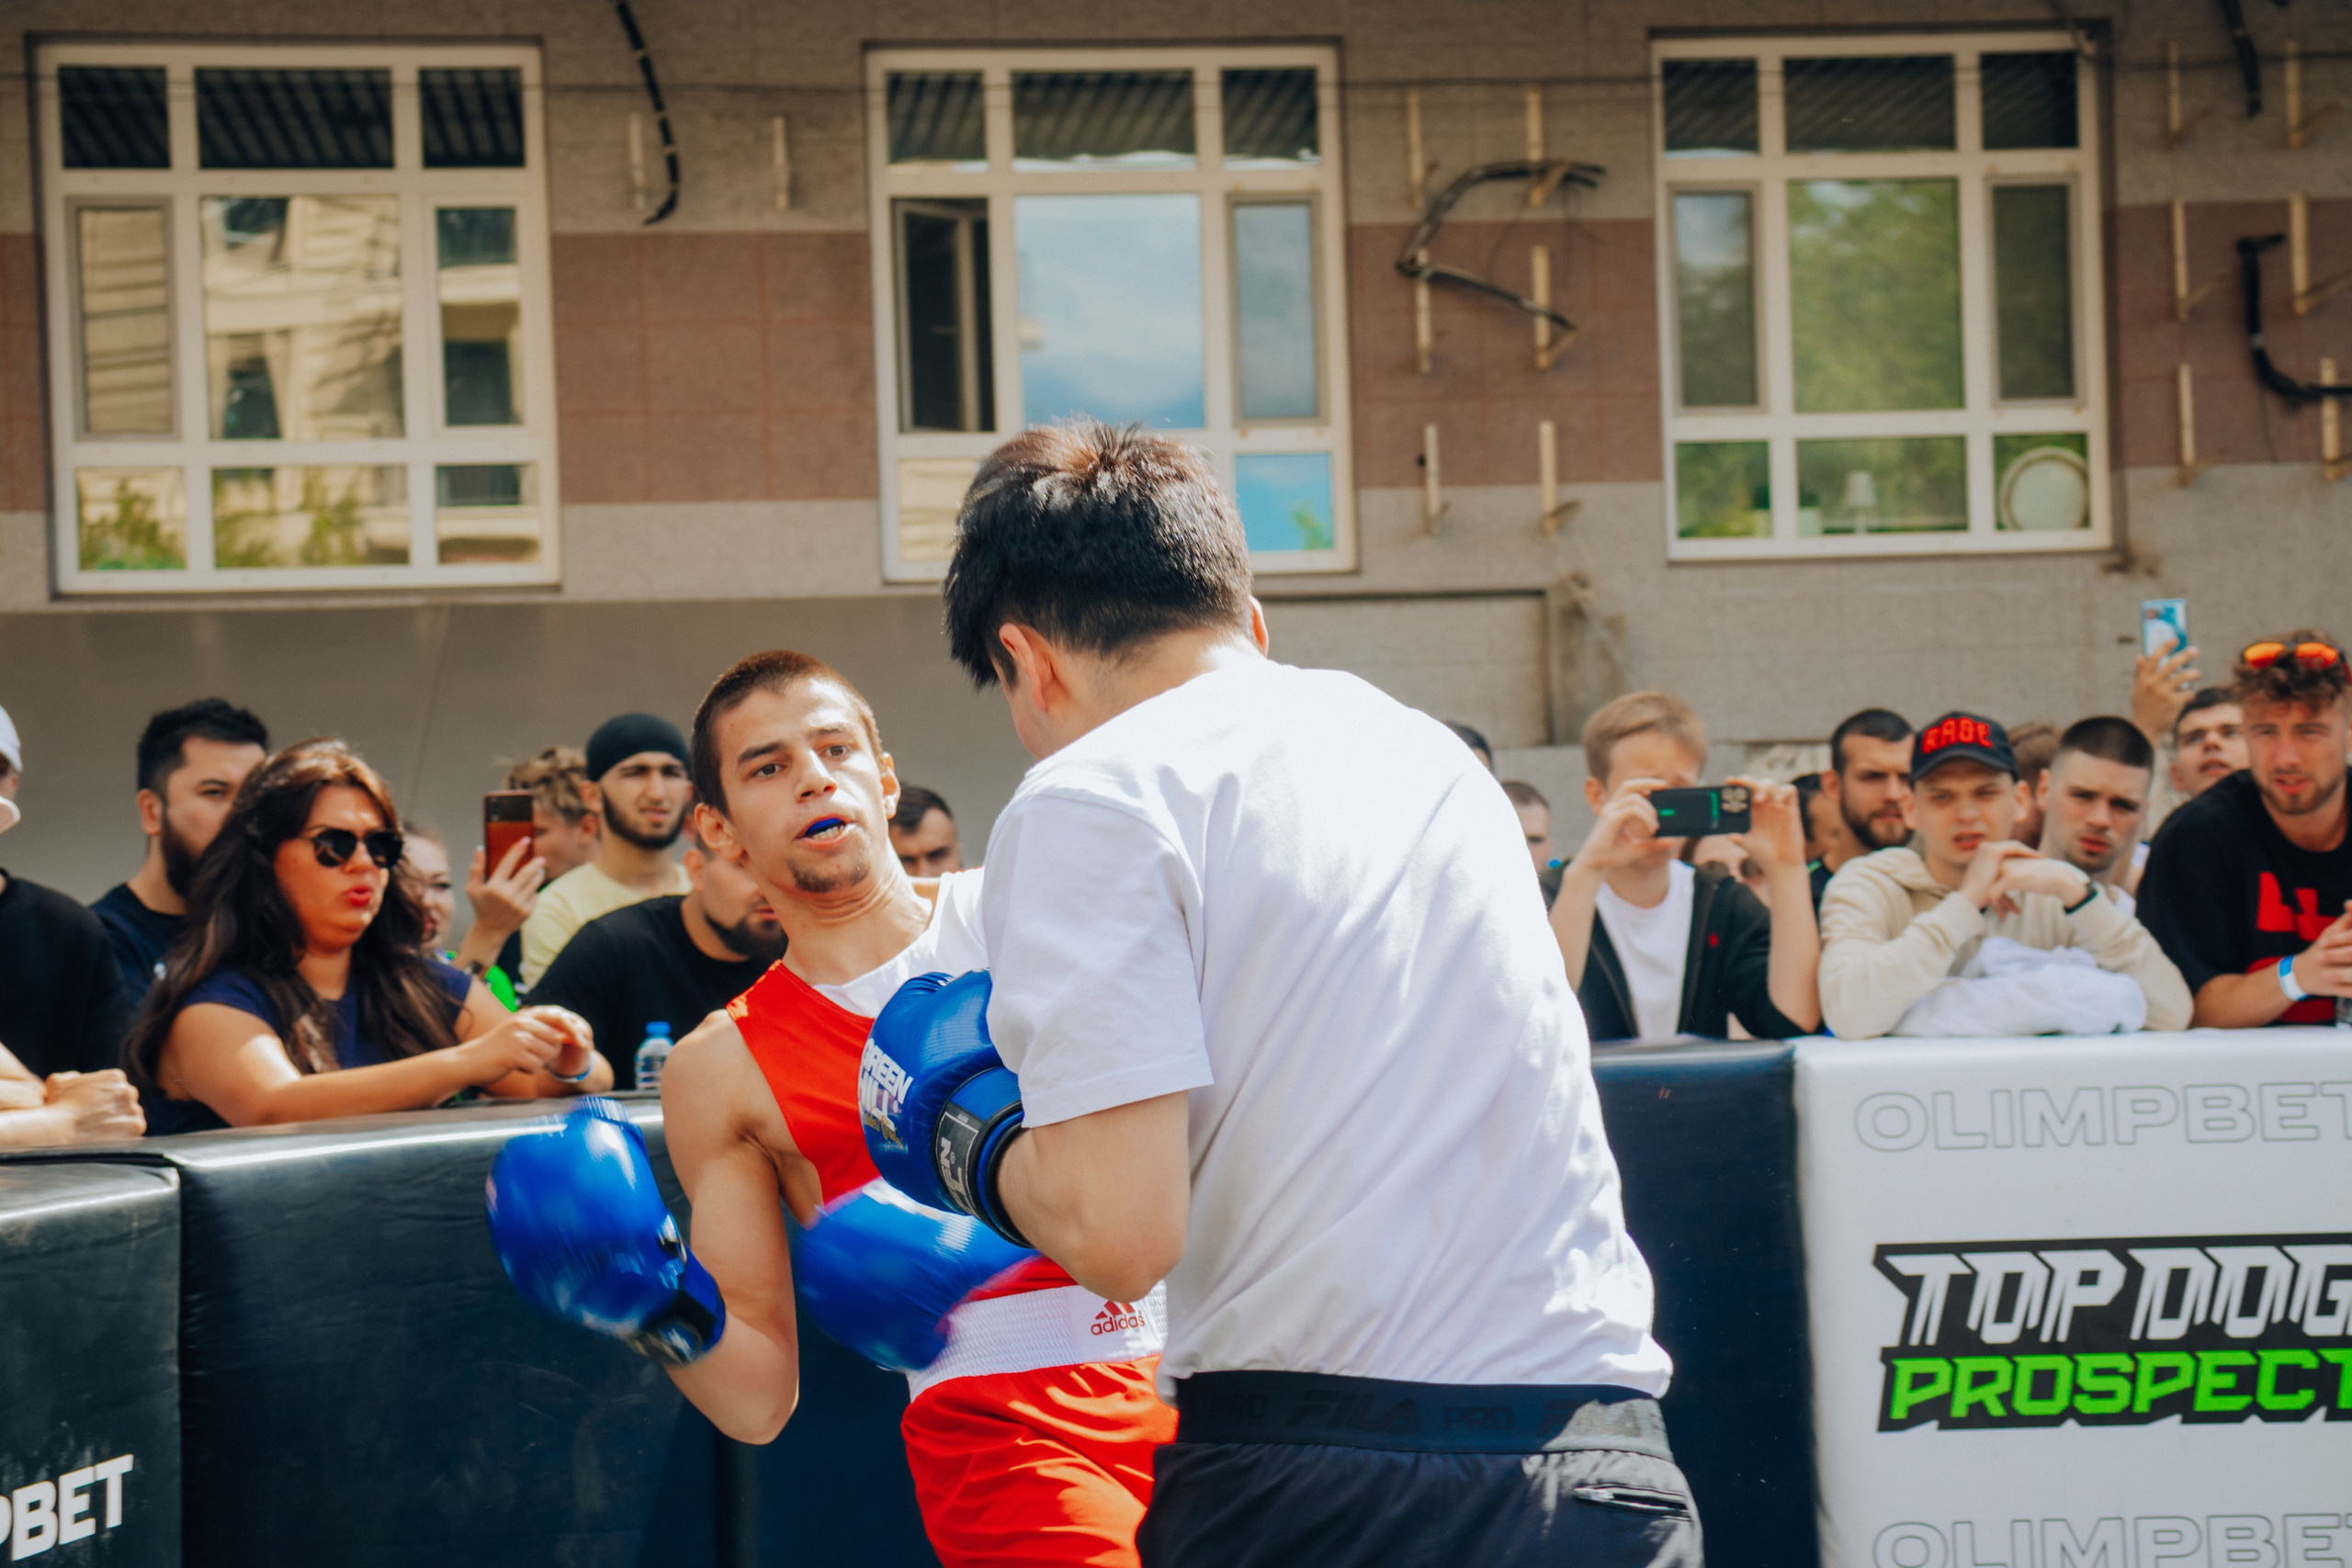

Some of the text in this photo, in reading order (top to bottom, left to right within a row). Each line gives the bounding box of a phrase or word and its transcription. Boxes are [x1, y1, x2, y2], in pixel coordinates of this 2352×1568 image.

[1884, 1244, 2352, 1347] TOP DOG
[1091, 1314, 1146, 1336] adidas
[1287, 1389, 1422, 1435] FILA
[0, 1454, 134, 1562] BET
[1872, 1513, 2352, 1568] OLIMPBE
